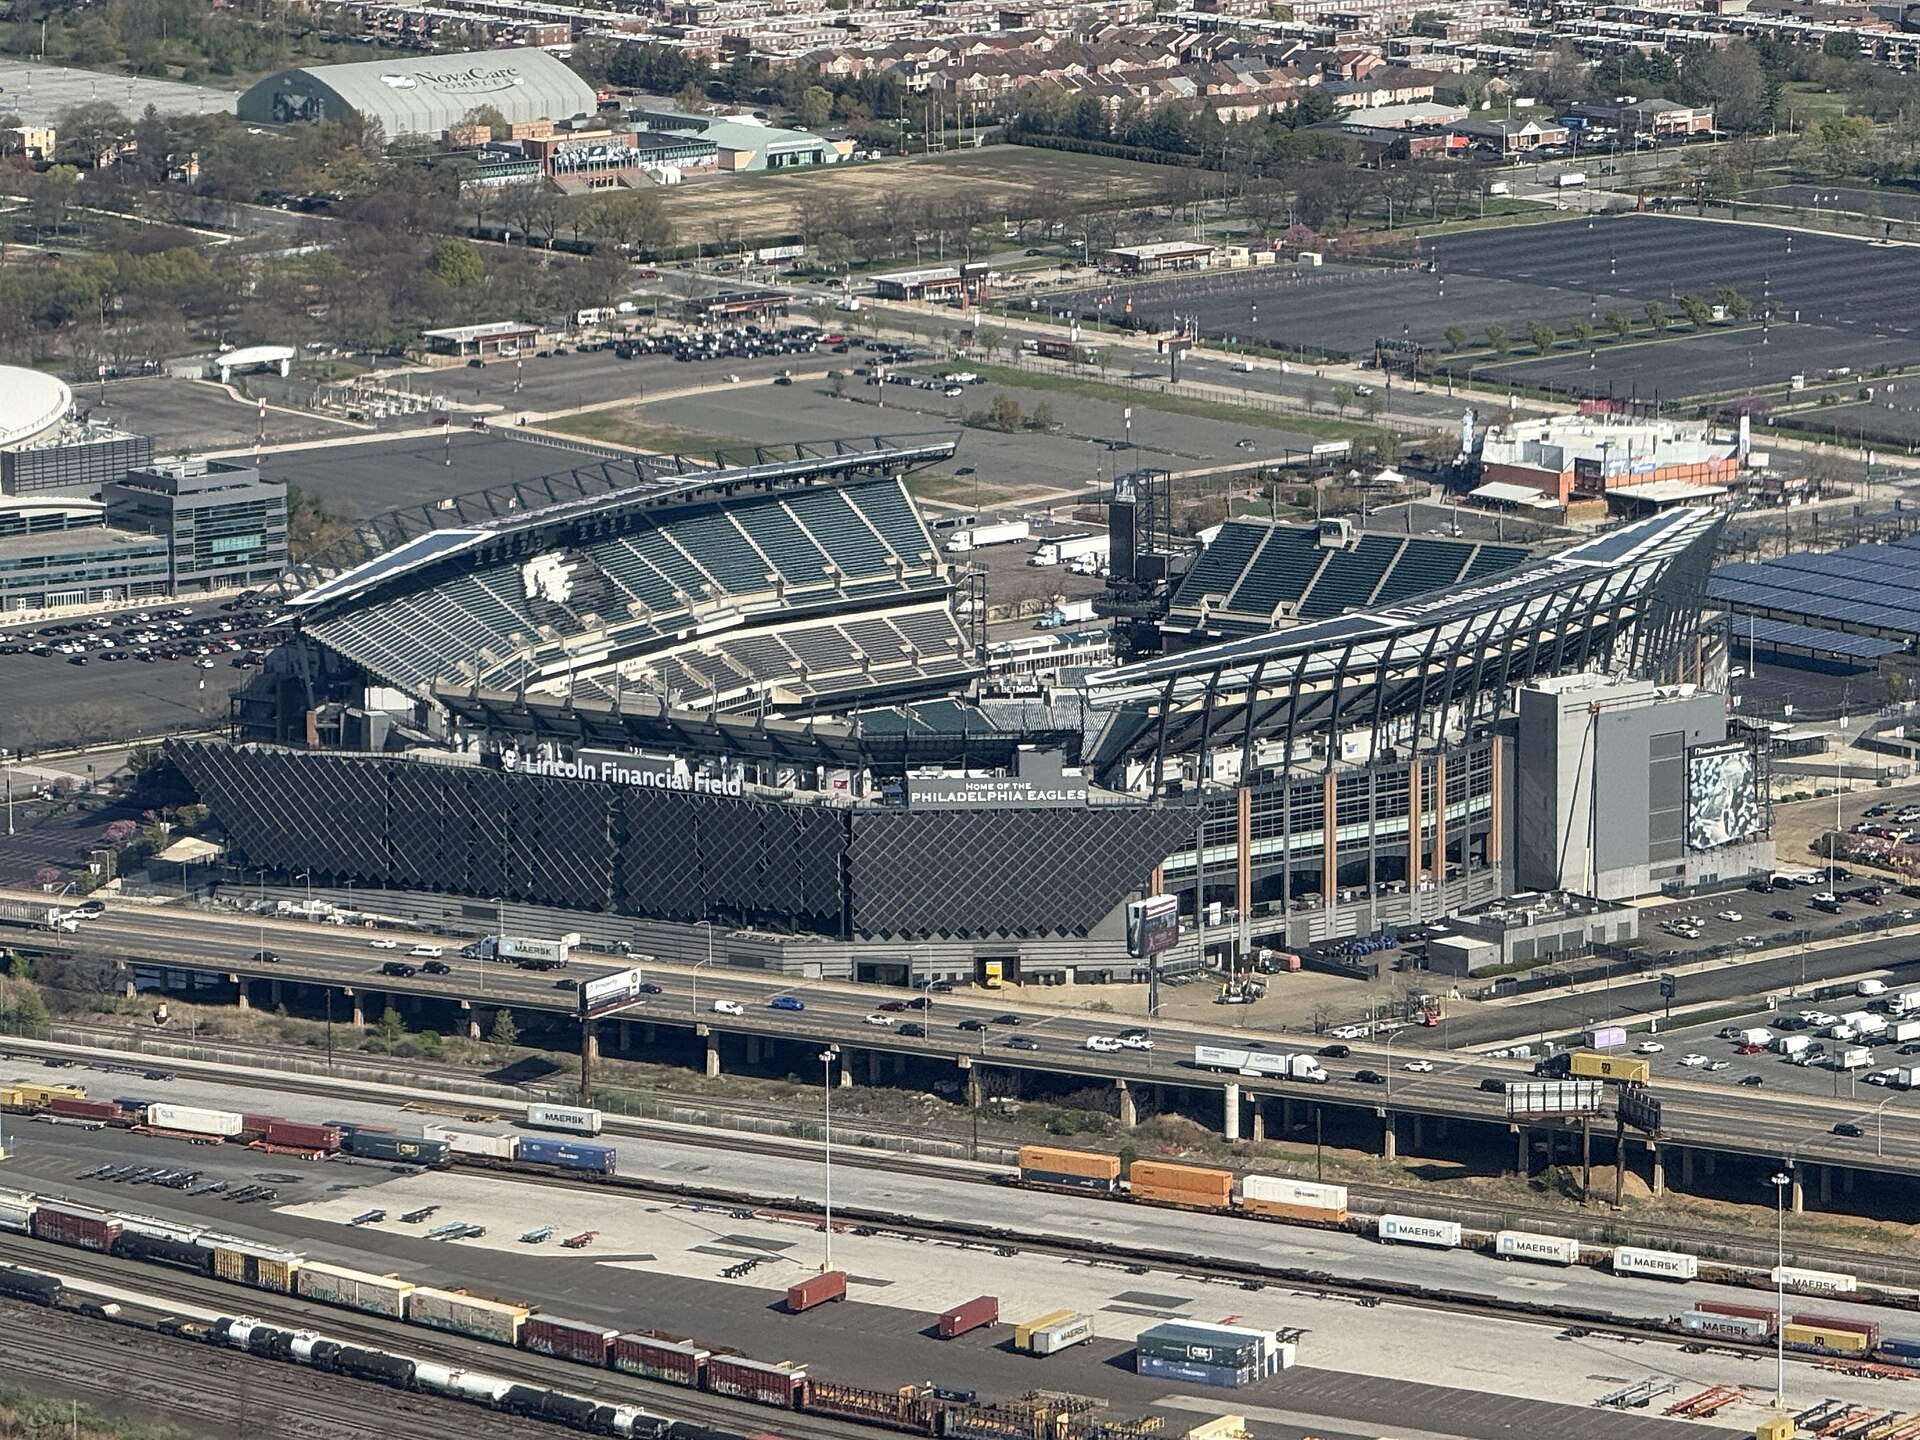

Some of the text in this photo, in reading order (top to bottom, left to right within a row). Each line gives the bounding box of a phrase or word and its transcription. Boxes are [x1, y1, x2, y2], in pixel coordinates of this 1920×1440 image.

[414, 67, 520, 85] NovaCare
[1000, 685, 1038, 693] BETMGM
[525, 753, 741, 796] Lincoln Financial Field
[965, 781, 1032, 791] HOME OF THE
[911, 789, 1087, 802] PHILADELPHIA EAGLES
[514, 944, 552, 955] MAERSK
[545, 1113, 584, 1124] MAERSK
[1399, 1225, 1442, 1238] MAERSK
[1516, 1242, 1560, 1255] MAERSK
[1634, 1259, 1679, 1271] MAERSK
[1060, 1324, 1088, 1340] MAERSK
[1702, 1321, 1748, 1336] MAERSK
